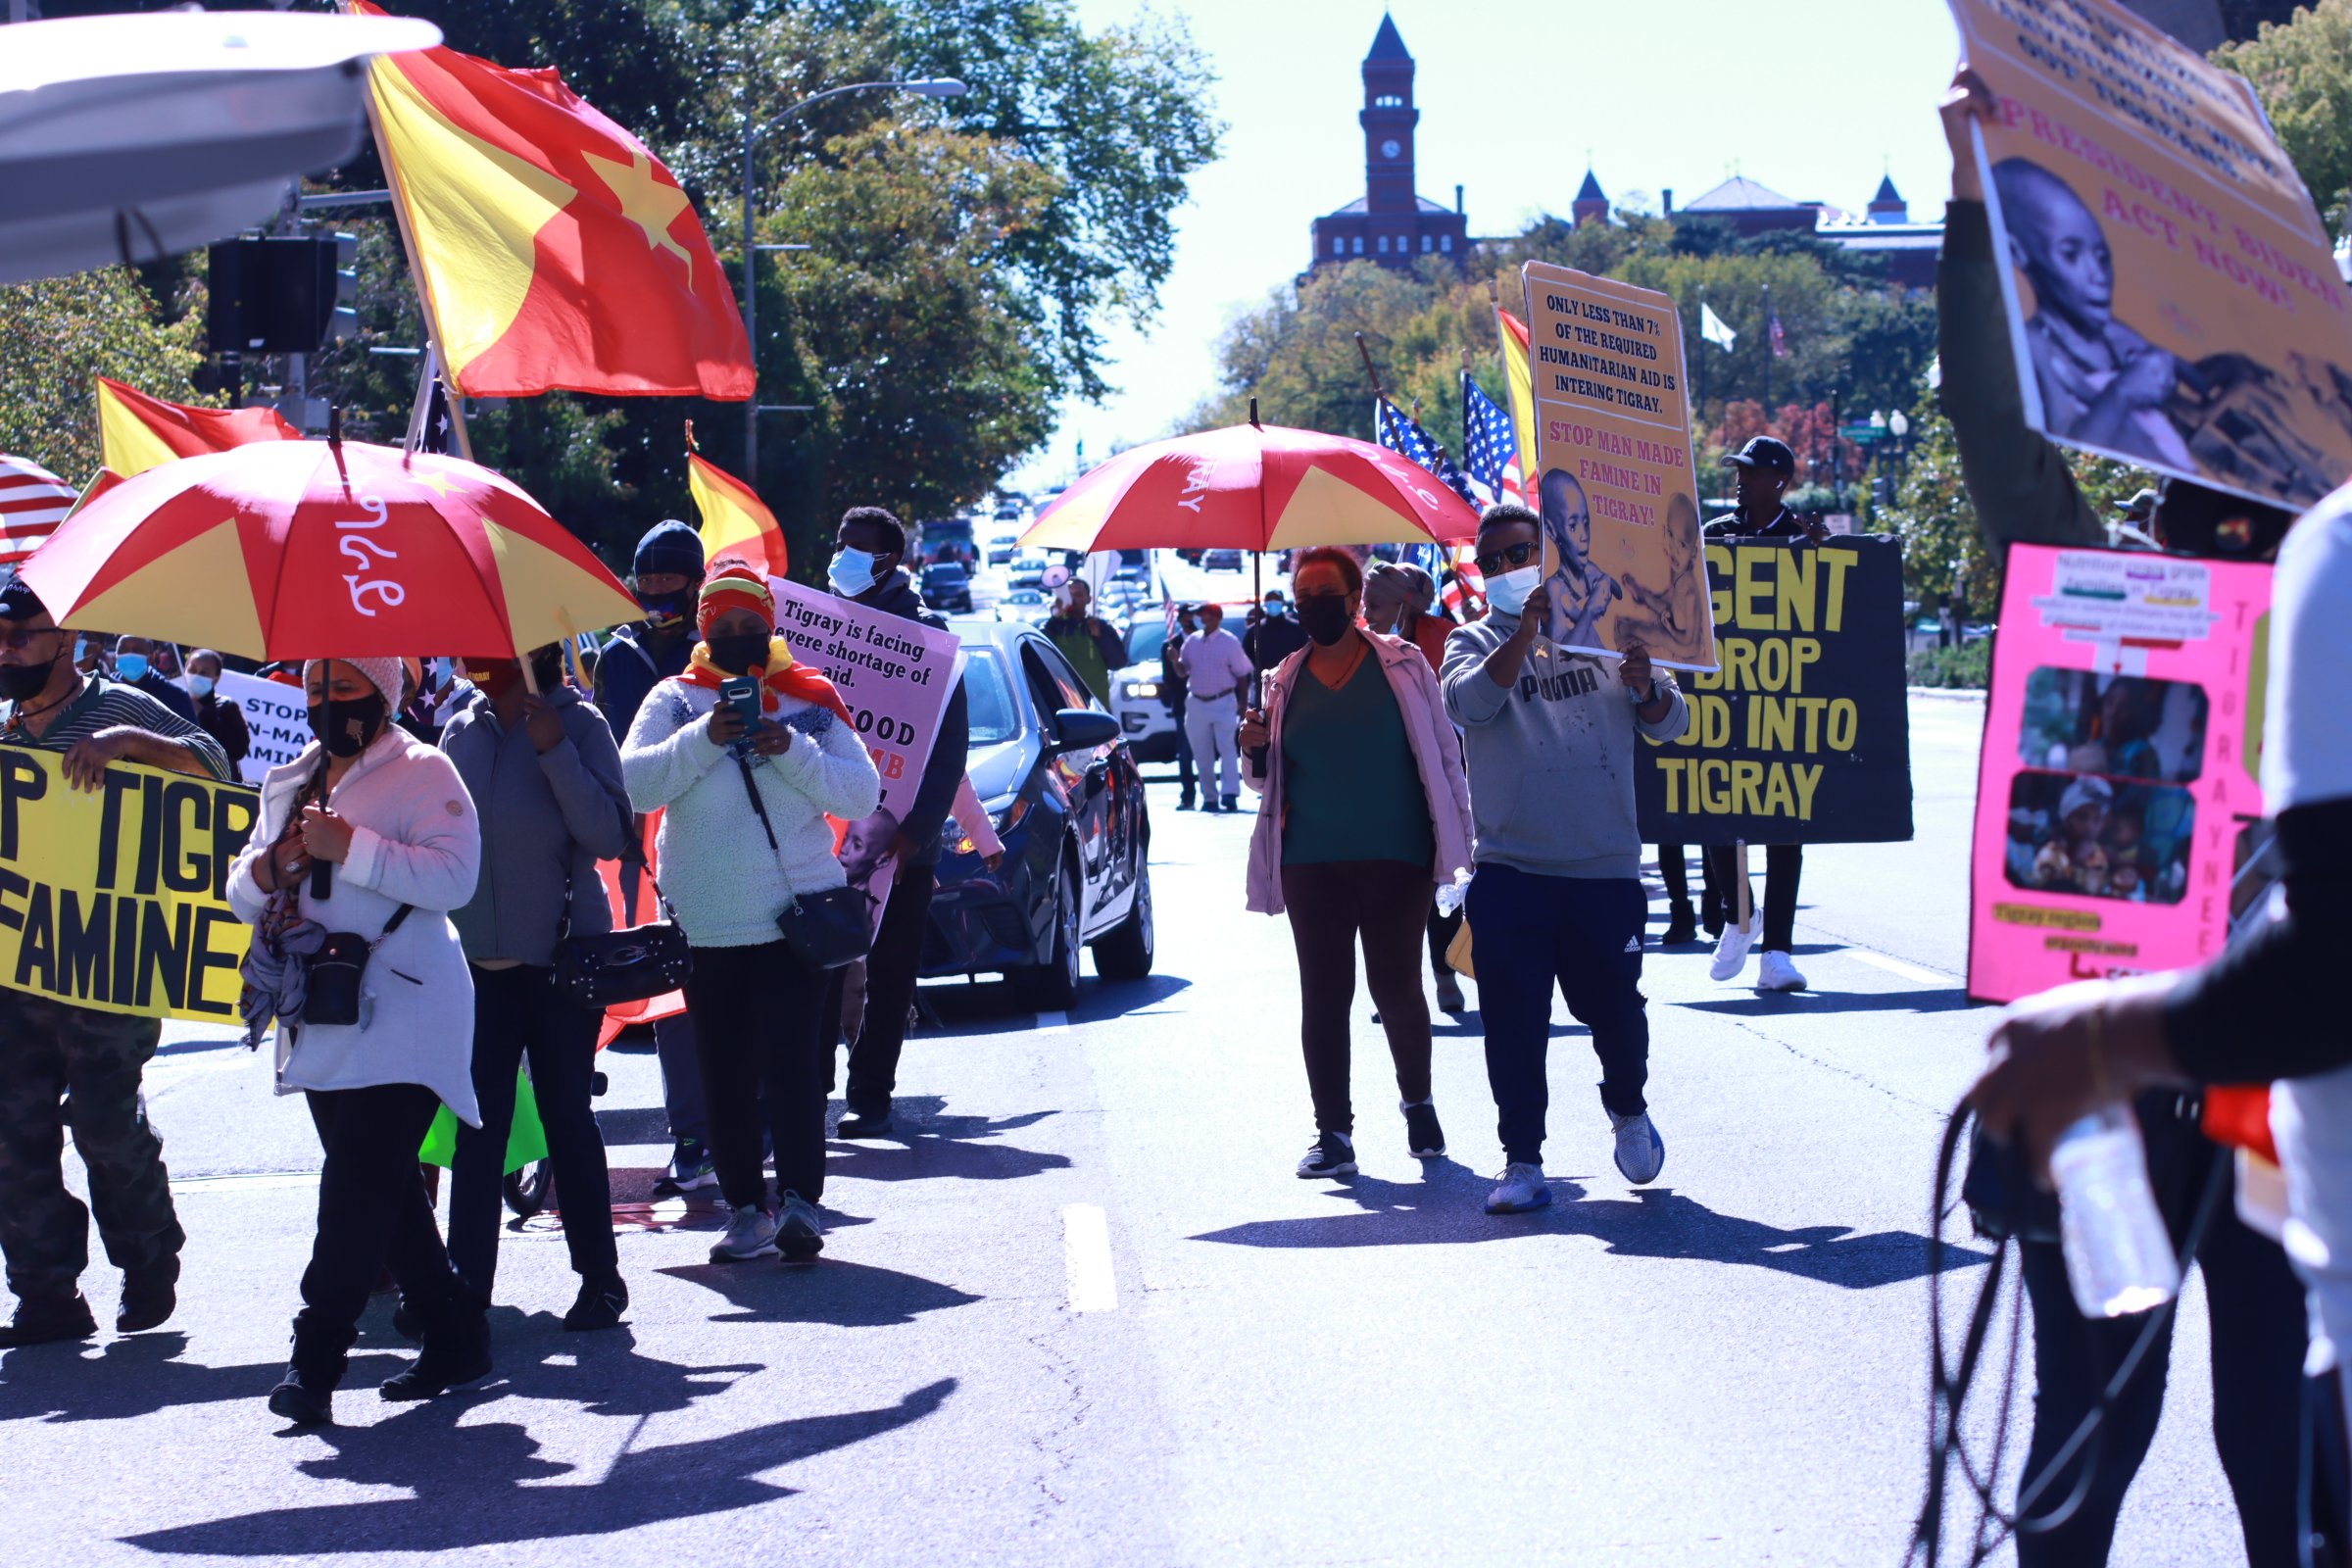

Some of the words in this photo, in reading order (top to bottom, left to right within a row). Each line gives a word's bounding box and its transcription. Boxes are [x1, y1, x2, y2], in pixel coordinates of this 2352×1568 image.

[2001, 96, 2222, 236] PRESIDENT
[2231, 222, 2346, 314] BIDEN
[2103, 184, 2180, 251] ACT
[2190, 232, 2297, 315] NOW!
[1547, 295, 1579, 316] ONLY
[1582, 303, 1611, 323] LESS
[1613, 311, 1644, 333] THAN
[1647, 319, 1660, 337] 7%
[1555, 322, 1572, 340] OF
[1575, 326, 1598, 346] THE
[1600, 333, 1657, 361] REQUIRED
[1540, 346, 1637, 382] HUMANITARIAN
[1640, 368, 1661, 387] AID
[1663, 373, 1676, 391] IS
[1555, 375, 1614, 402] INTERING
[1616, 388, 1663, 414] TIGRAY.
[1549, 420, 1593, 447] STOP
[1596, 430, 1633, 457] MAN
[1637, 440, 1684, 467] MADE
[1579, 459, 1641, 491] FAMINE
[1643, 473, 1662, 495] IN
[1592, 494, 1655, 526] TIGRAY!
[335, 495, 405, 616] ግራይ
[785, 599, 844, 637] Tigray
[846, 619, 862, 640] is
[865, 625, 926, 662] facing
[821, 665, 856, 687] aid.
[826, 640, 906, 679] shortage
[910, 667, 931, 686] of
[1520, 667, 1598, 703] PUMA
[1694, 637, 1821, 694] DROP
[246, 698, 308, 722] STOP
[1642, 693, 1731, 748] OD
[1747, 694, 1857, 754] INTO
[247, 721, 318, 747] N-MA
[1656, 758, 1824, 820] TIGRAY
